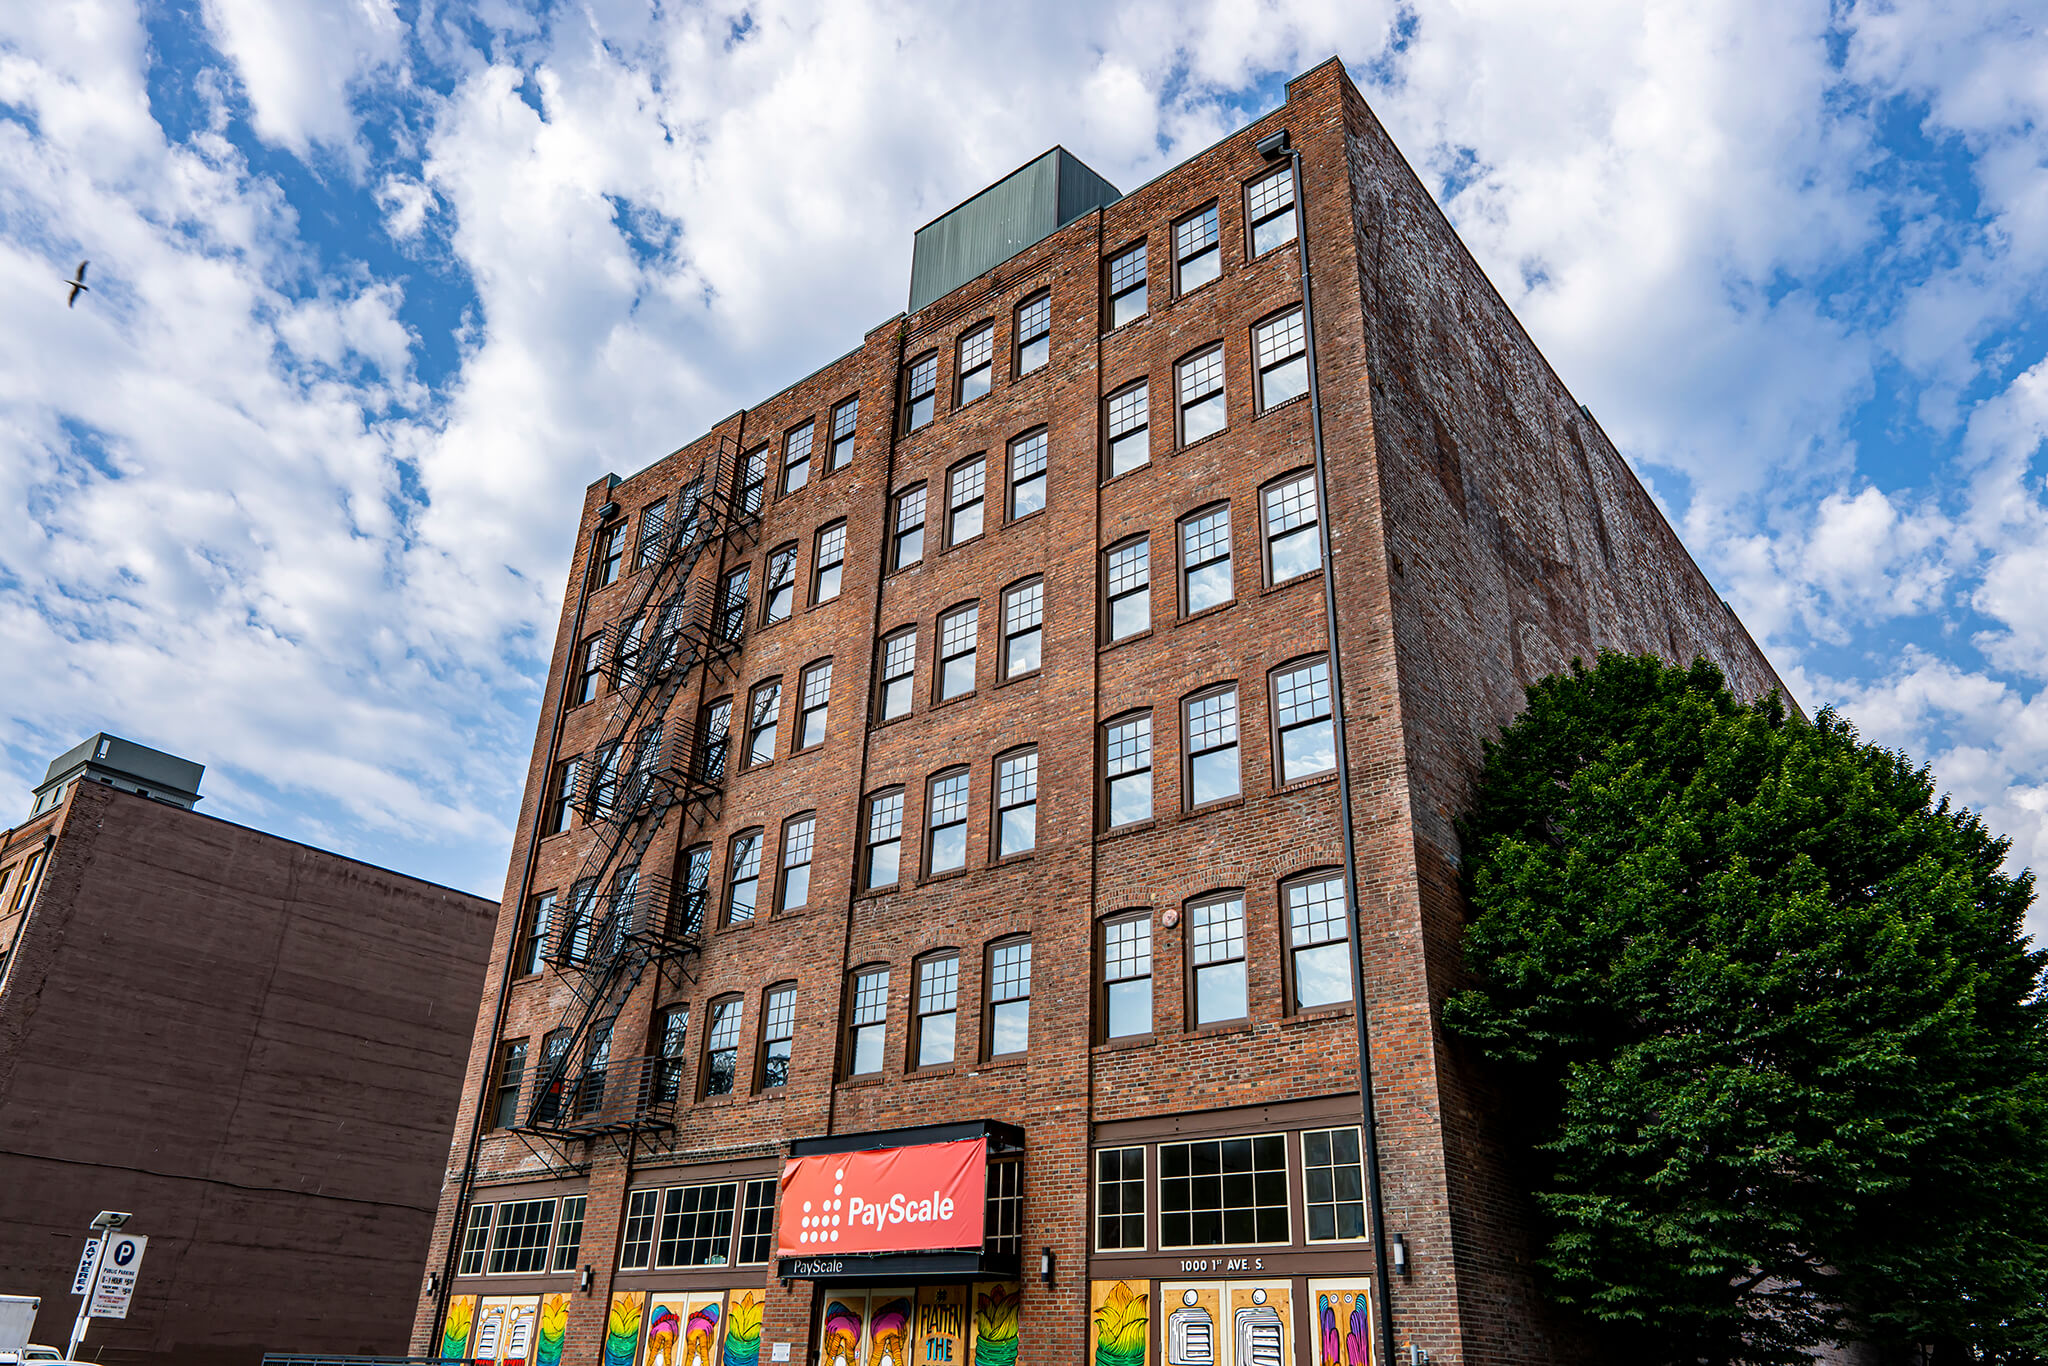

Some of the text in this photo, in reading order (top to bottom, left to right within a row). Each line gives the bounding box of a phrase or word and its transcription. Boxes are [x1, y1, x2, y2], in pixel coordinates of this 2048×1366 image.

[848, 1190, 954, 1232] PayScale
[77, 1241, 98, 1285] PAY HERE
[118, 1244, 132, 1262] P
[1180, 1260, 1207, 1272] 1000
[1227, 1258, 1251, 1271] AVE.
[1255, 1258, 1265, 1270] S.
[794, 1259, 843, 1276] PayScale
[919, 1303, 962, 1340] FLATTEN
[926, 1337, 953, 1362] THE
